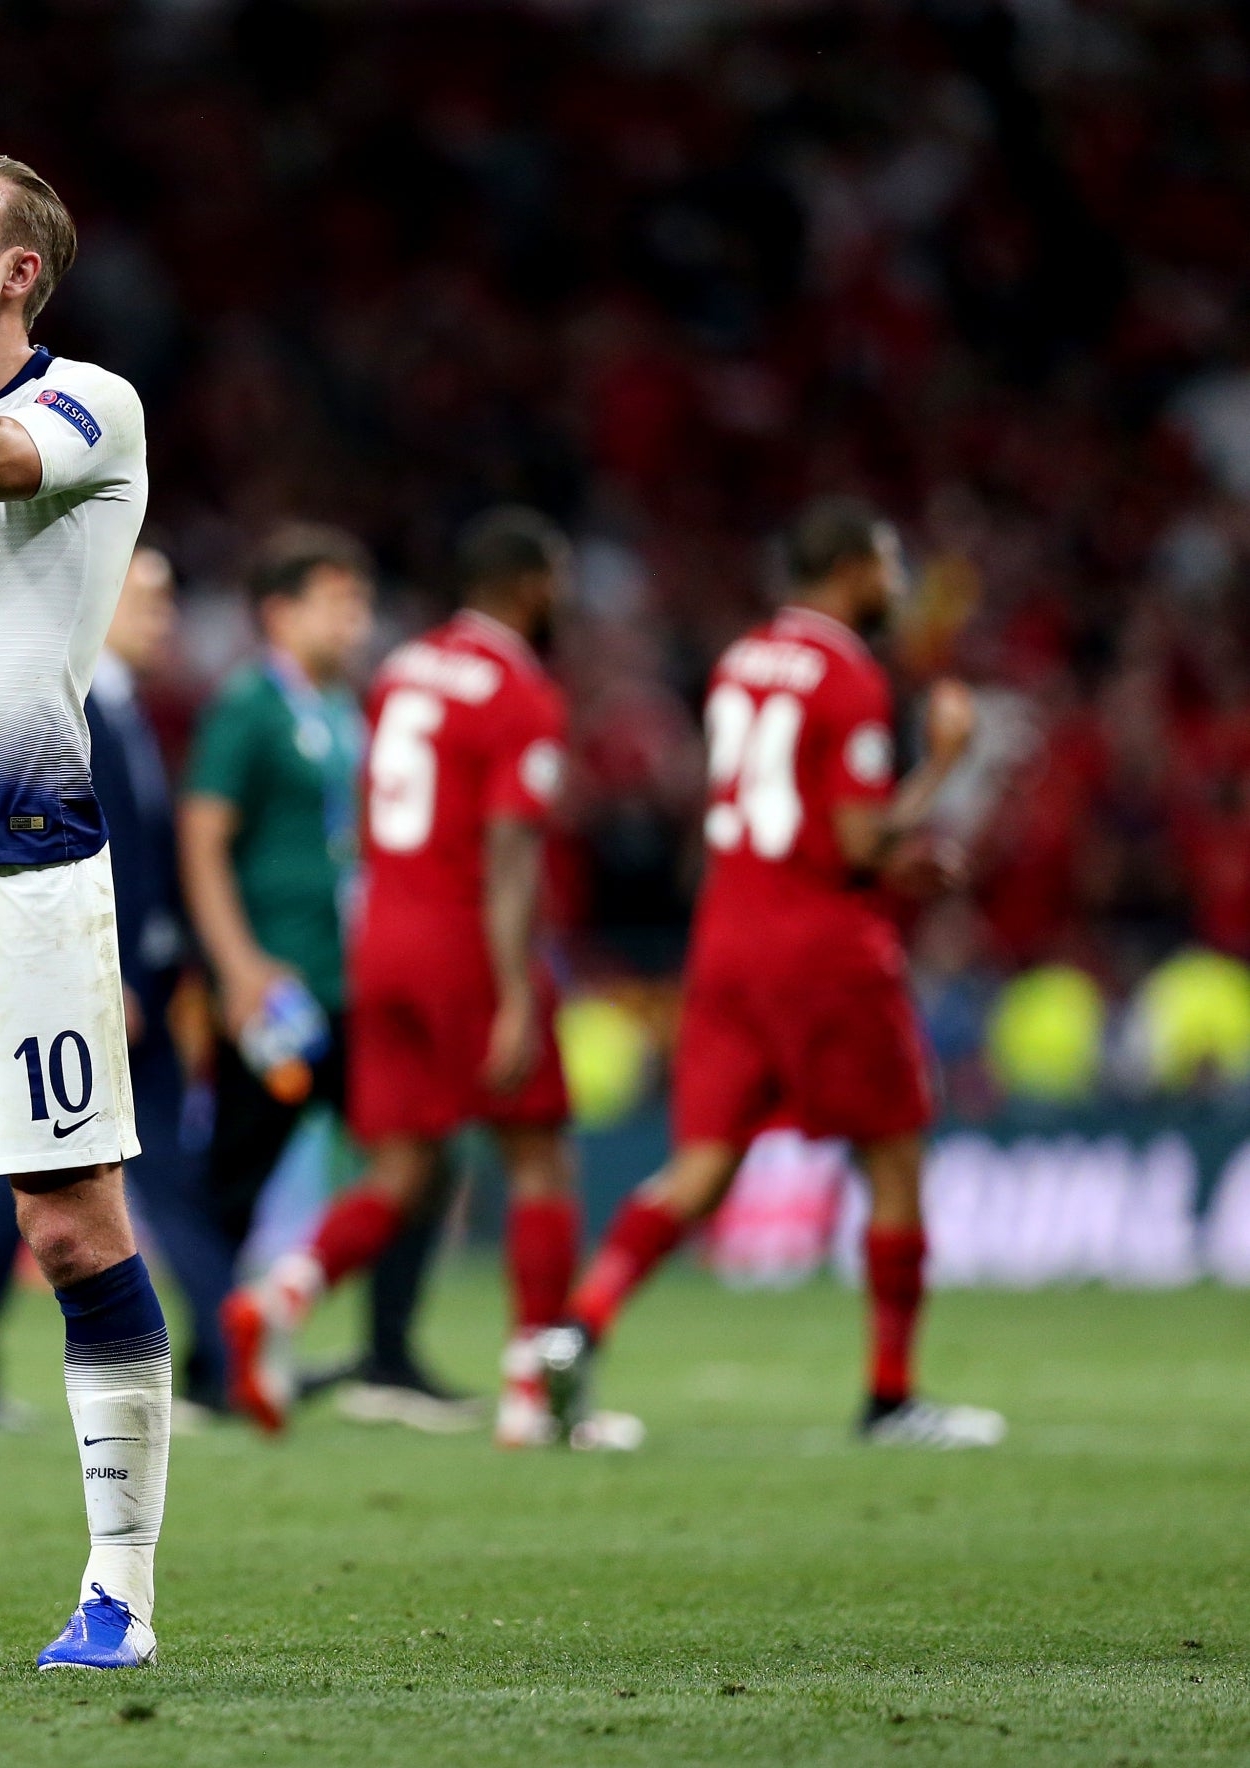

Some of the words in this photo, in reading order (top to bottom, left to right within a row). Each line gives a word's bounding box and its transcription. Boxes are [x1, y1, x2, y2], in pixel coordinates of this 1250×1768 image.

[55, 398, 98, 441] RESPECT
[370, 688, 444, 853] 5
[14, 1030, 92, 1121] 10
[85, 1467, 128, 1480] SPURS
